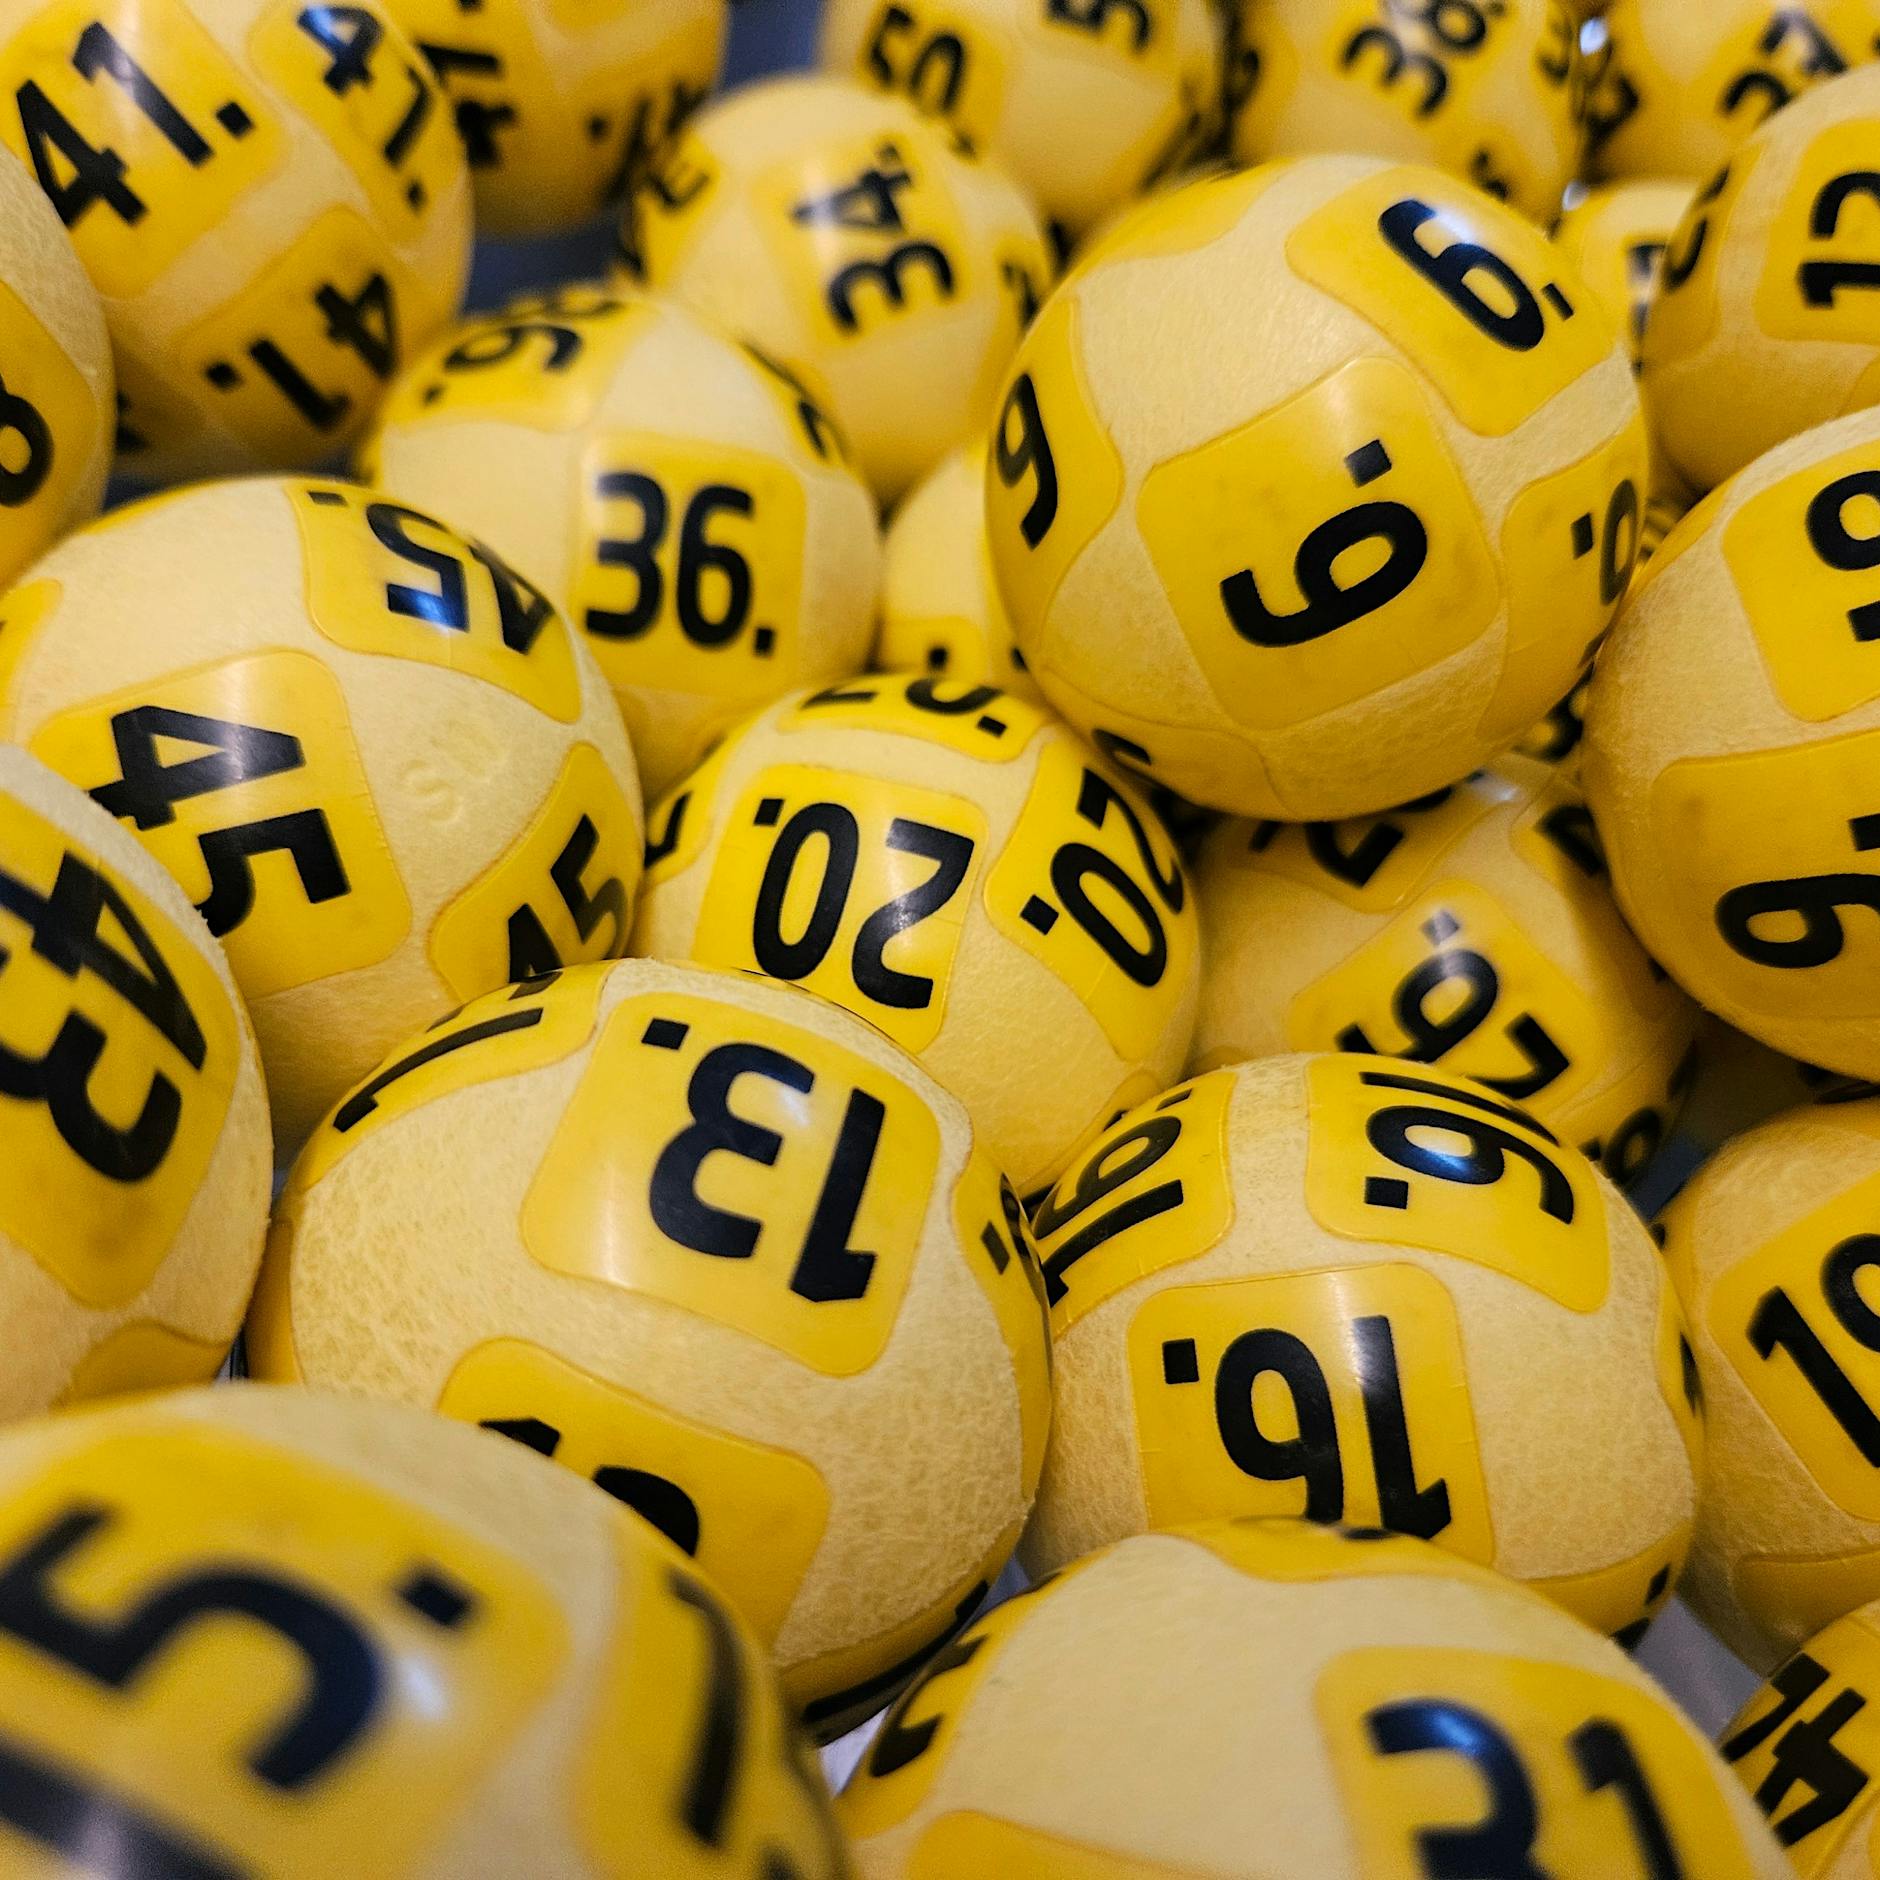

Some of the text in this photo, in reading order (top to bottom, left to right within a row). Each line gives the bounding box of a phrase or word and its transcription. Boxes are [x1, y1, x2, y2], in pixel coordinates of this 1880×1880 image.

[15, 21, 255, 230] 41.
[204, 272, 398, 430] 41.
[583, 470, 776, 657] 36.
[752, 797, 976, 1010] 20.
[1020, 767, 1184, 988] 20.
[640, 1017, 886, 1303] 13.
[1360, 1070, 1575, 1226] 16.
[1161, 1314, 1453, 1541] 16.
